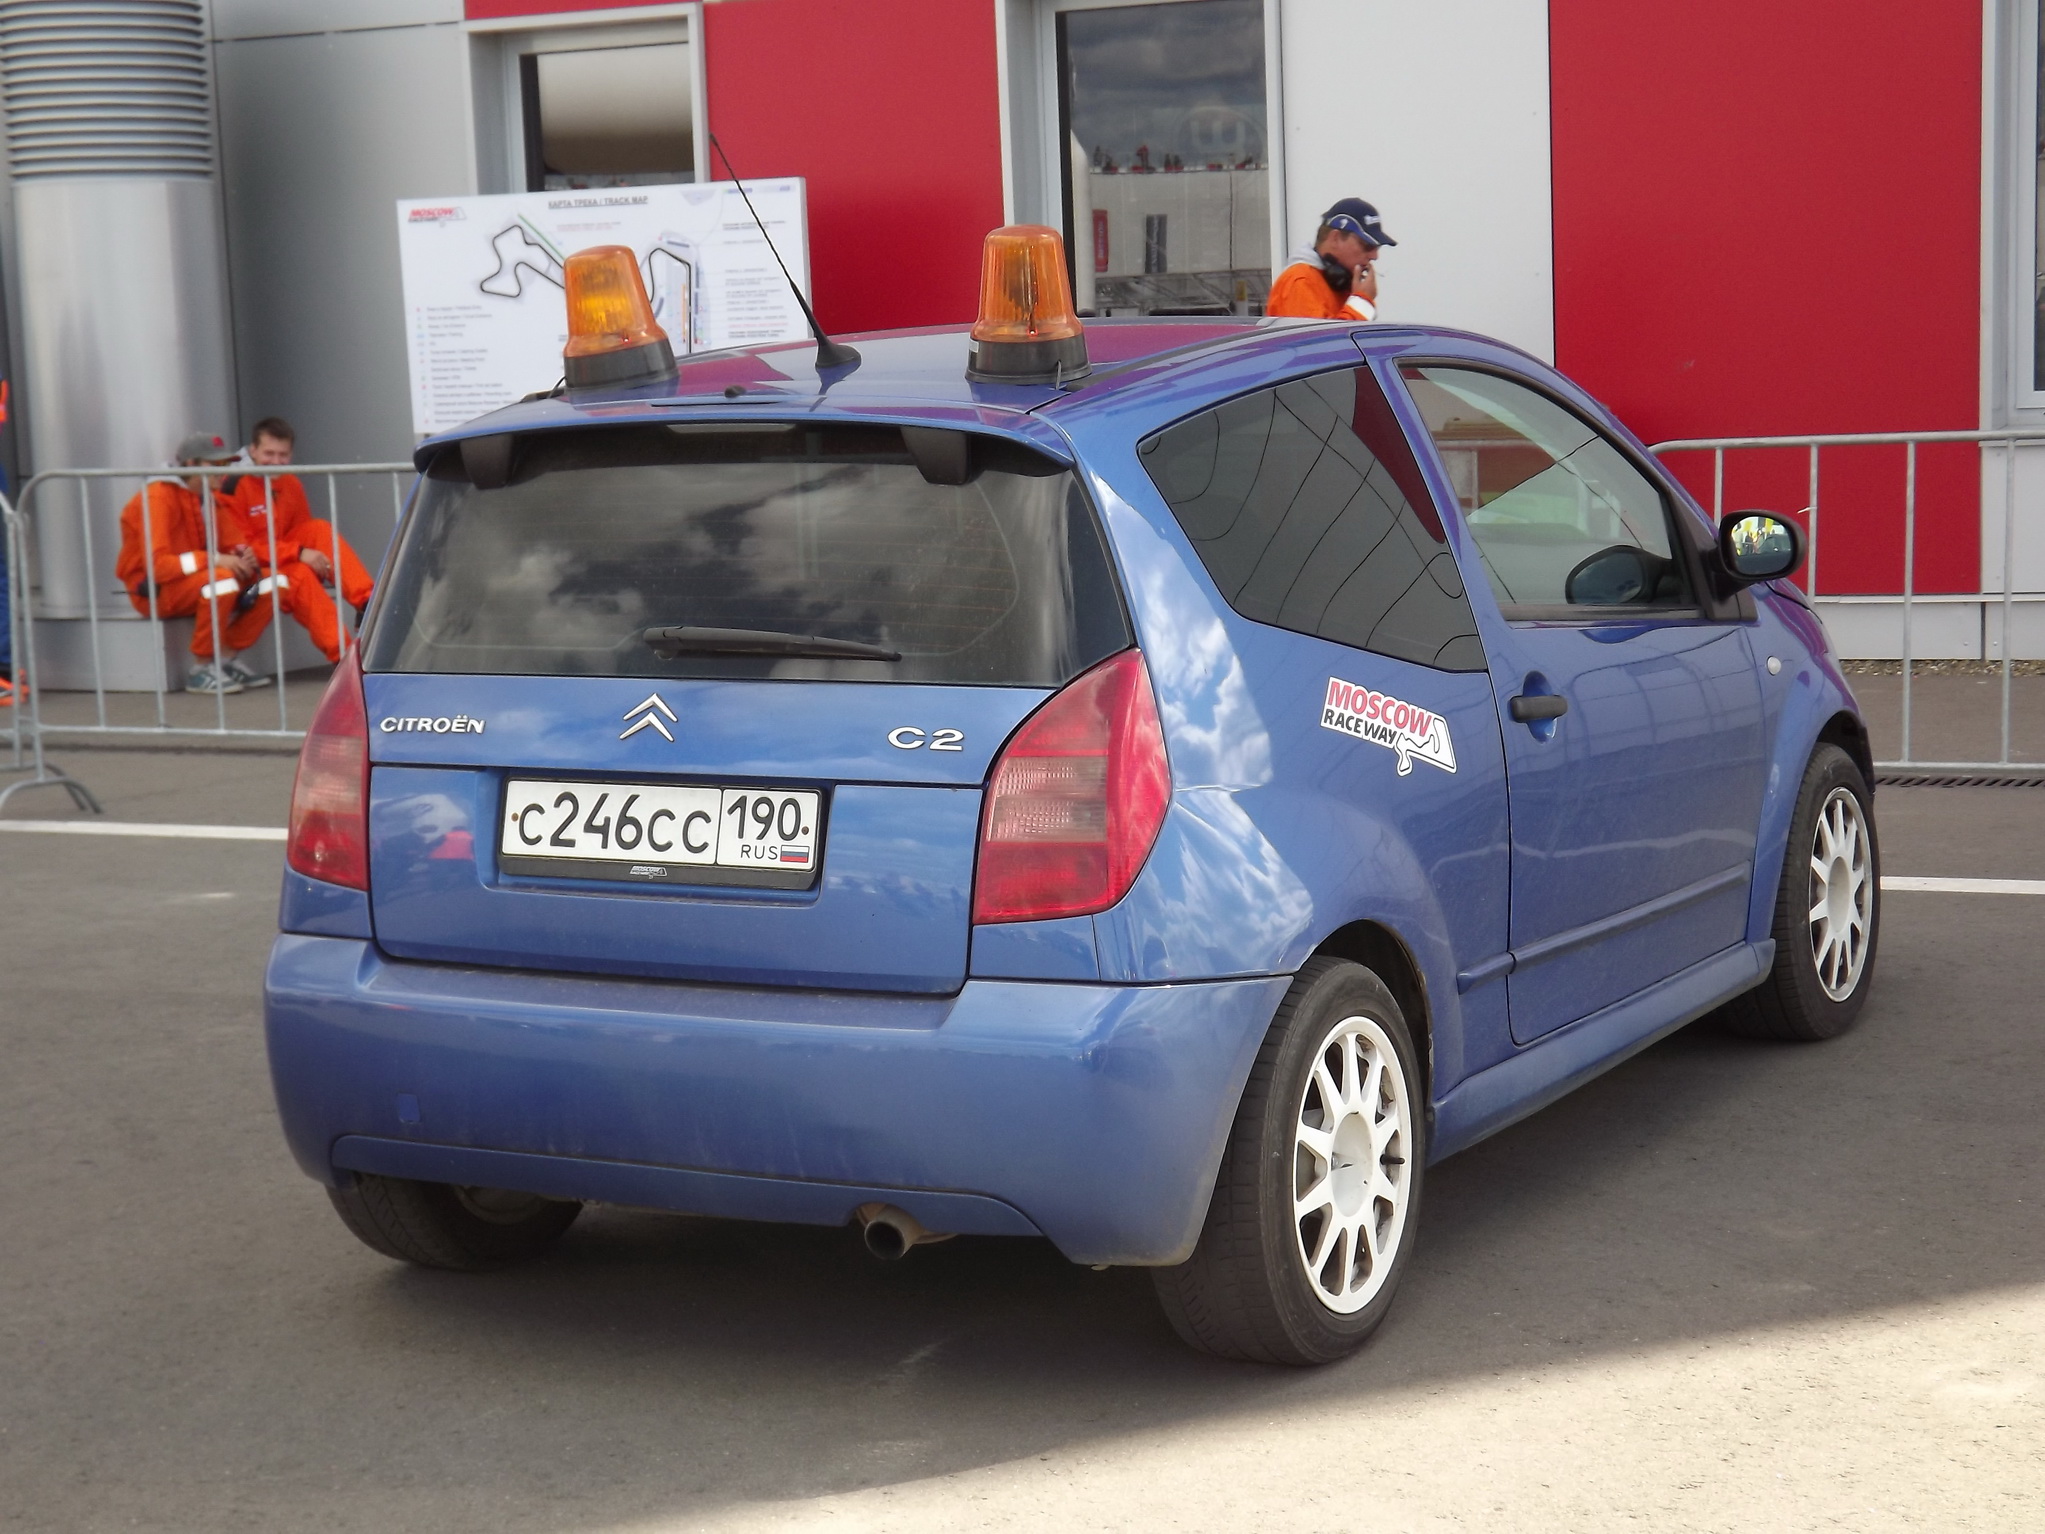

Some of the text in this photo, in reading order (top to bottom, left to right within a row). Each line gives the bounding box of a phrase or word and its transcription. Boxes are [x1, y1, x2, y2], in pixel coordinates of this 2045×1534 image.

[380, 714, 486, 734] CITROËN
[1327, 681, 1432, 737] MOSCOW
[886, 726, 965, 752] C2
[1323, 708, 1398, 745] RACEWAY
[727, 795, 802, 841] 190
[740, 844, 779, 860] RUS
